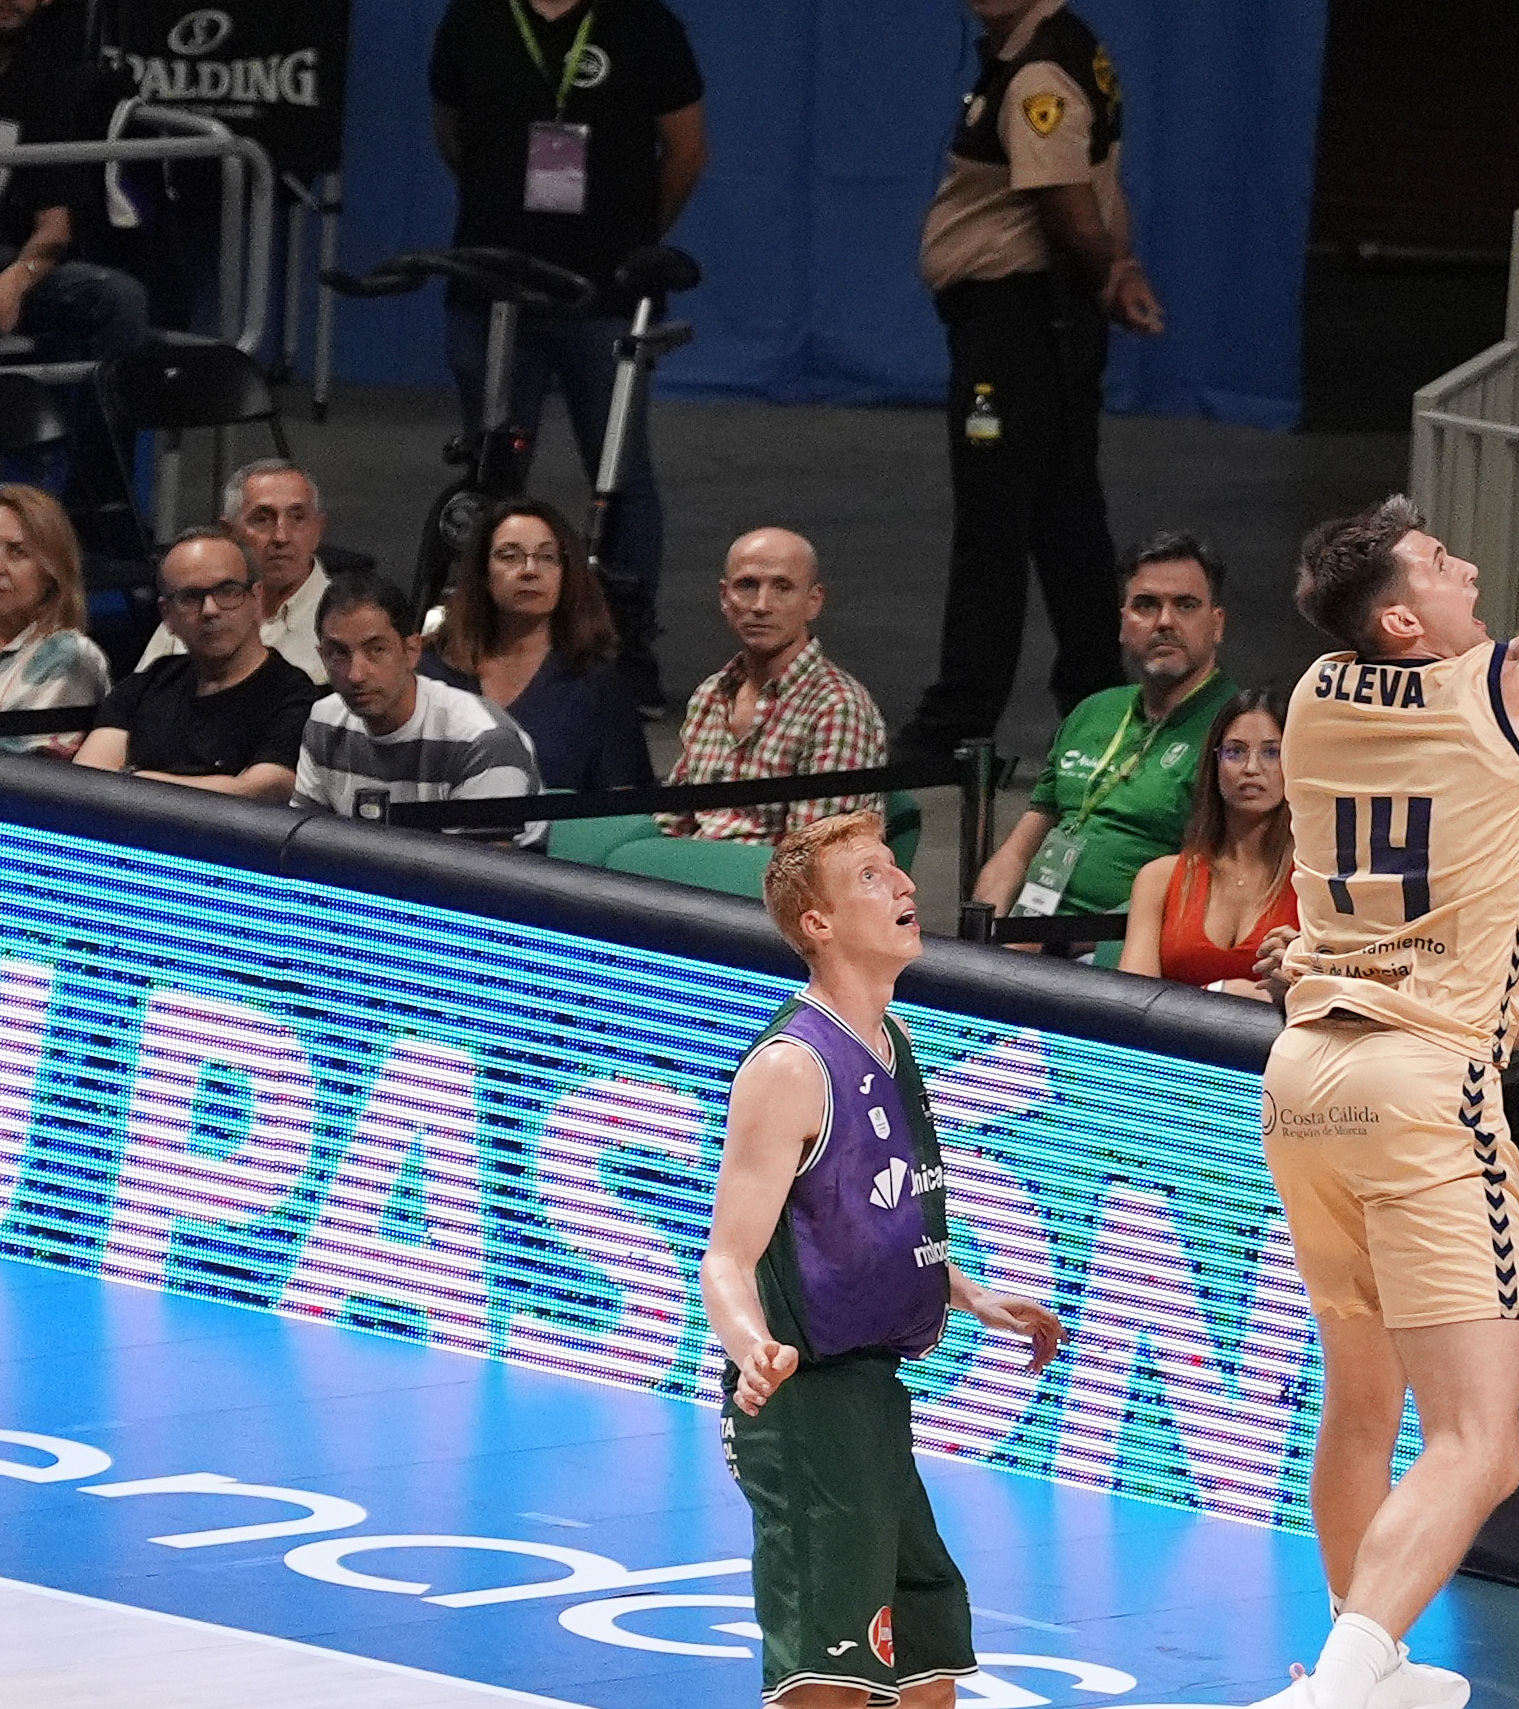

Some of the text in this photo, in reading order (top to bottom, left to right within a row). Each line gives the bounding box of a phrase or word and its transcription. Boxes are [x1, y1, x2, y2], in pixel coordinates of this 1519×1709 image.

[1315, 663, 1425, 709] SLEVA
[1328, 796, 1433, 922] 14
[1280, 1105, 1380, 1126] Costa Cálida
